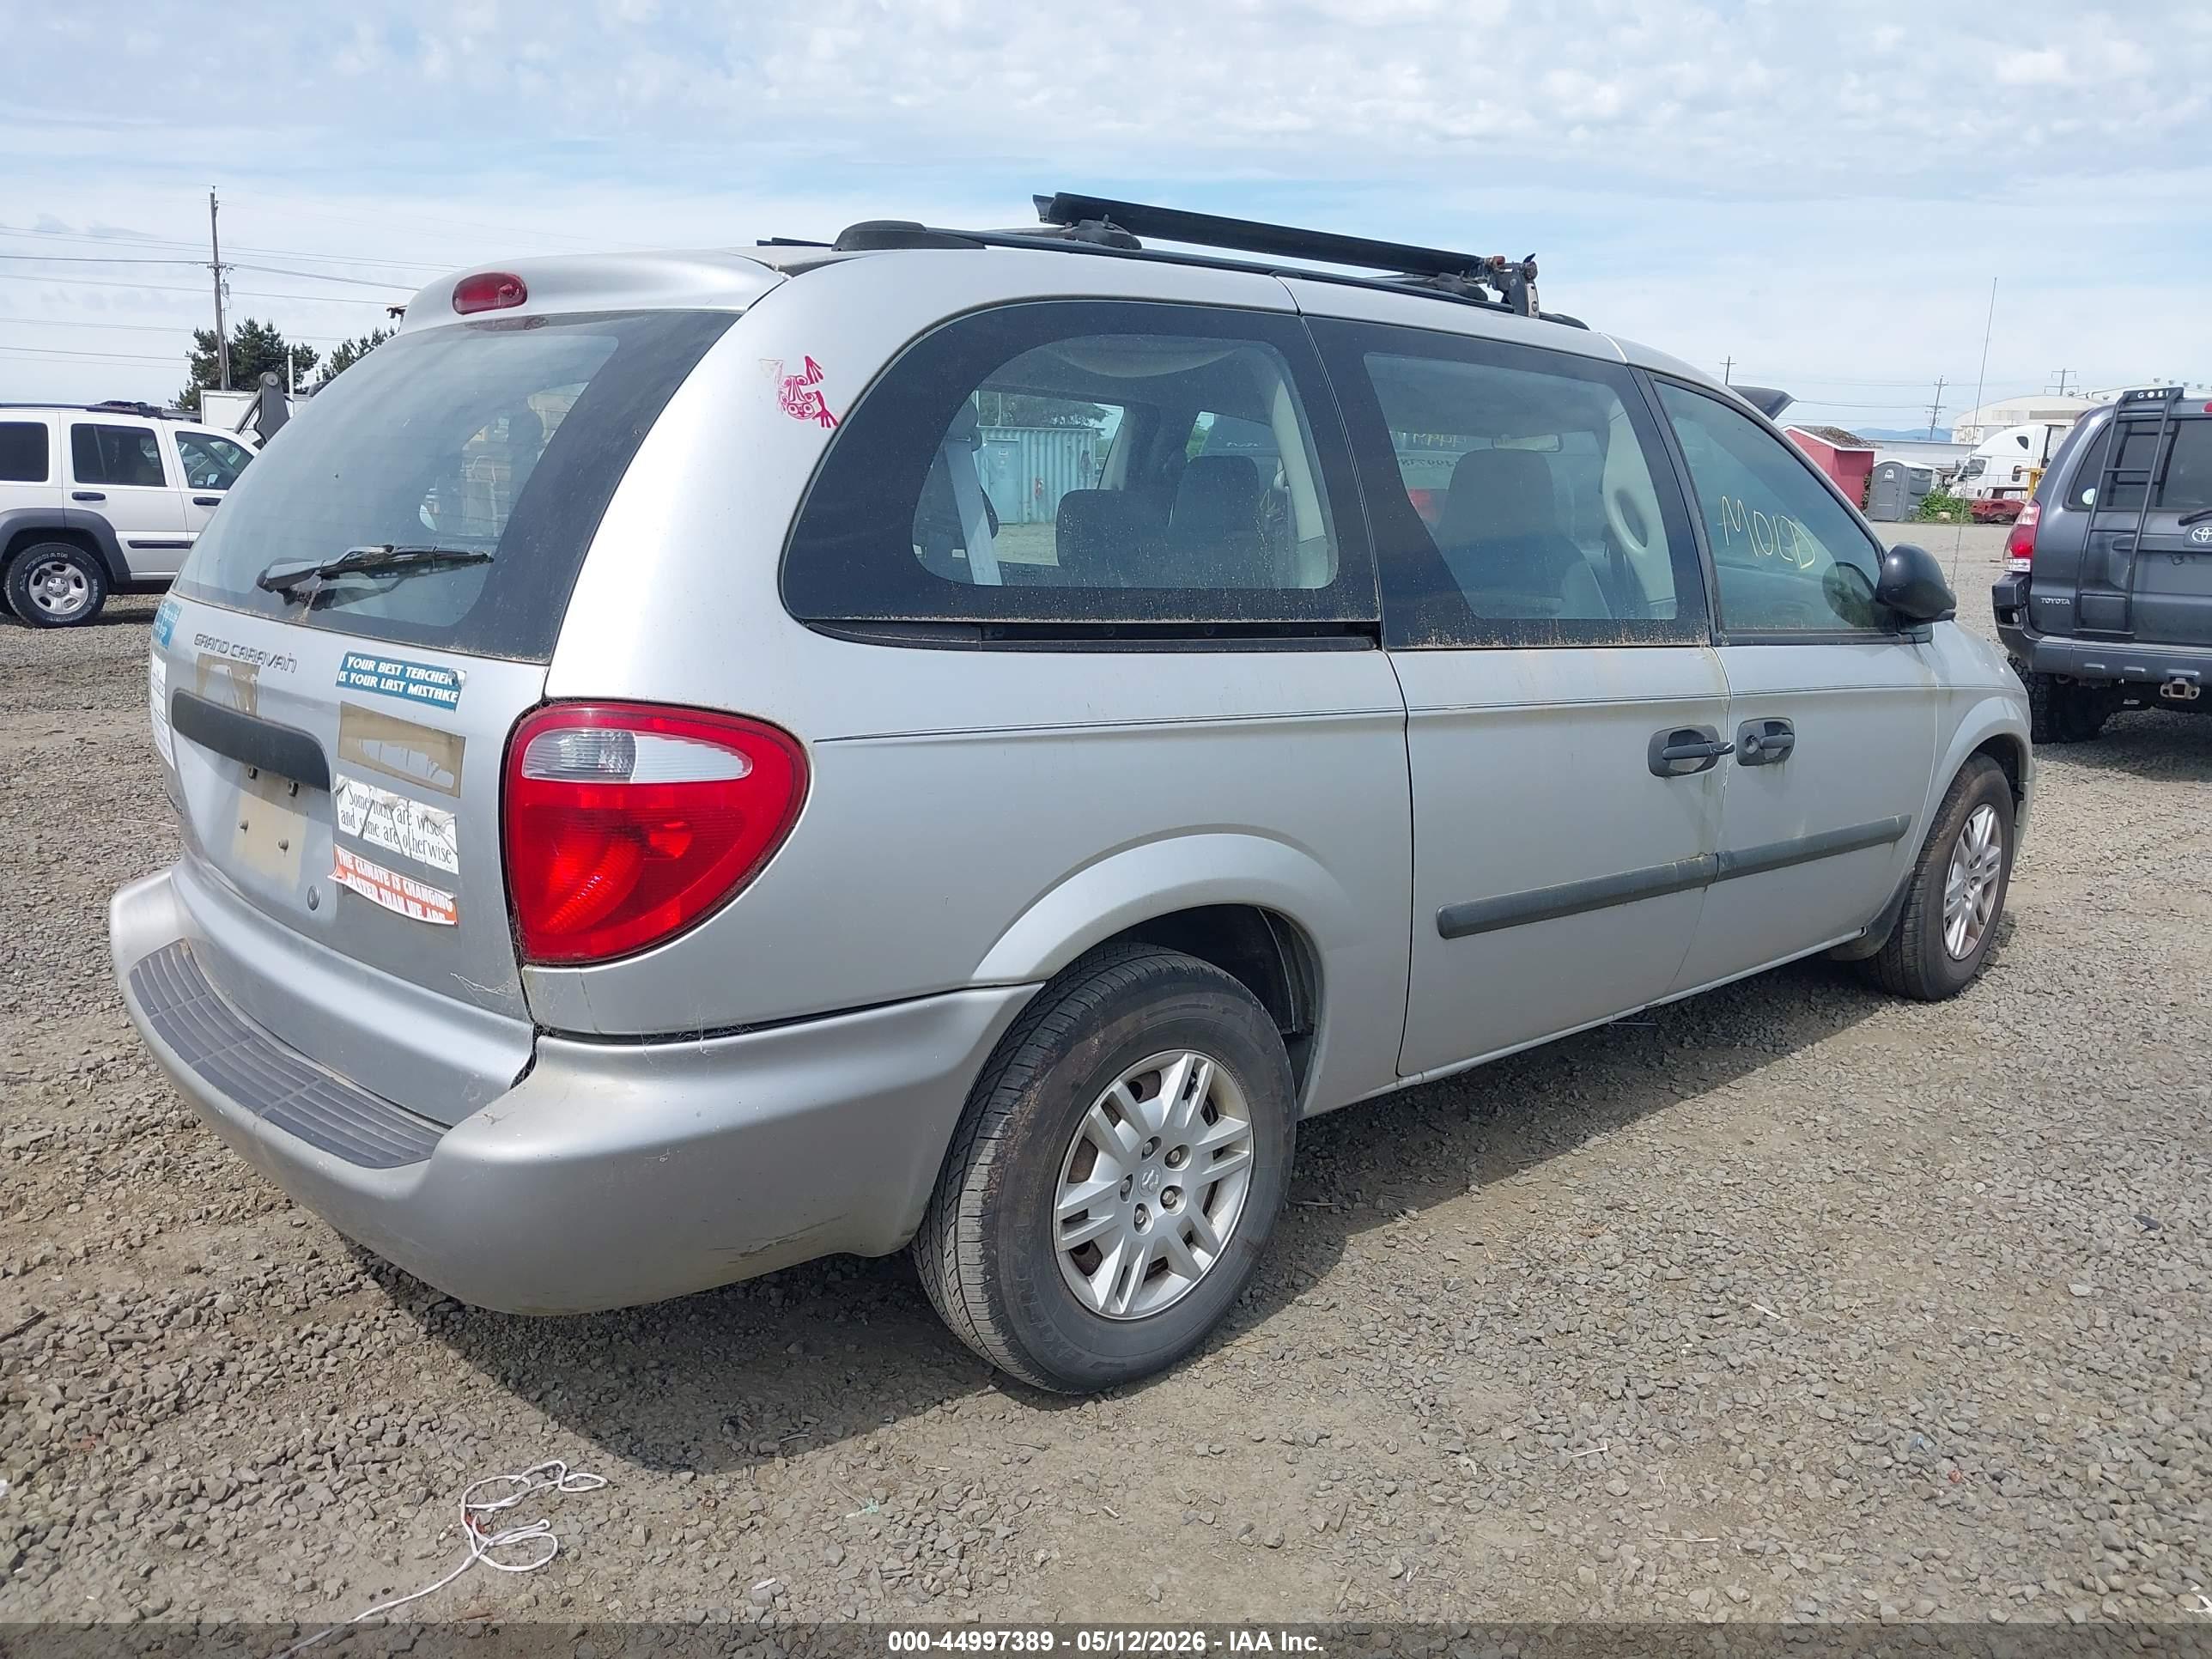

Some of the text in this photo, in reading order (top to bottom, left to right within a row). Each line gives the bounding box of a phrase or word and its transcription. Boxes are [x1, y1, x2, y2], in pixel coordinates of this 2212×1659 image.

[2137, 390, 2169, 398] GOBI
[1721, 495, 1815, 568] MOLD
[194, 633, 297, 673] GRAND CARAVAN
[346, 656, 453, 686] YOUR BEST TEACHER
[337, 671, 459, 702] IS YOUR LAST MISTAKE
[347, 782, 370, 811] Some
[397, 807, 412, 826] are
[341, 807, 356, 830] and
[383, 825, 399, 845] are
[337, 848, 453, 913] THE CLIMATE IS CHANGING
